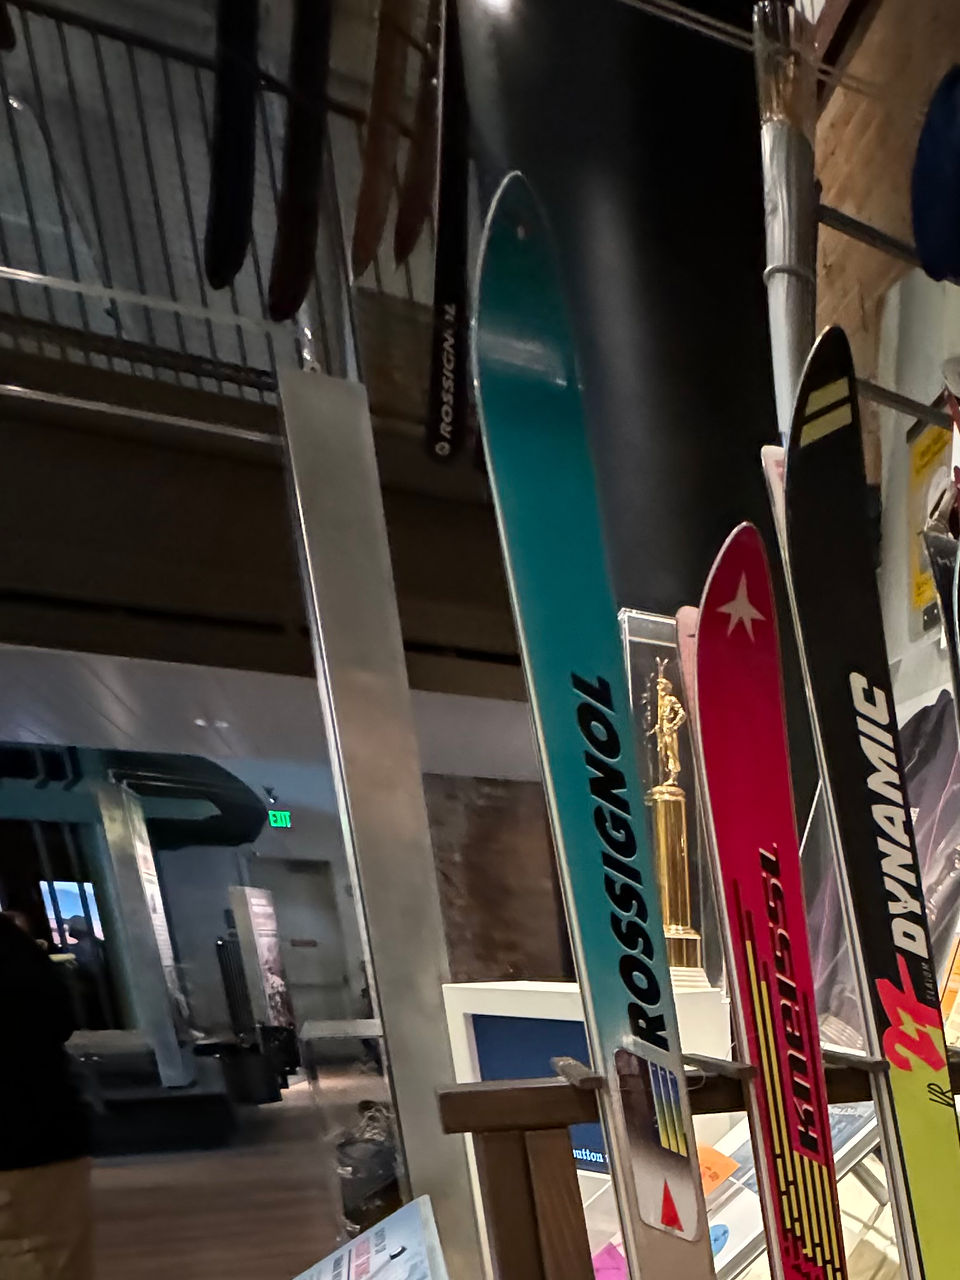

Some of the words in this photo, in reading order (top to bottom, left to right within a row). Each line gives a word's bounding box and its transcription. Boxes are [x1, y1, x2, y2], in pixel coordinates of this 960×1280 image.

[439, 303, 456, 439] ROSSIGNL
[269, 810, 291, 828] EXIT
[571, 671, 670, 1052] ROSSIGNOL
[849, 671, 929, 959] DYNAMIC
